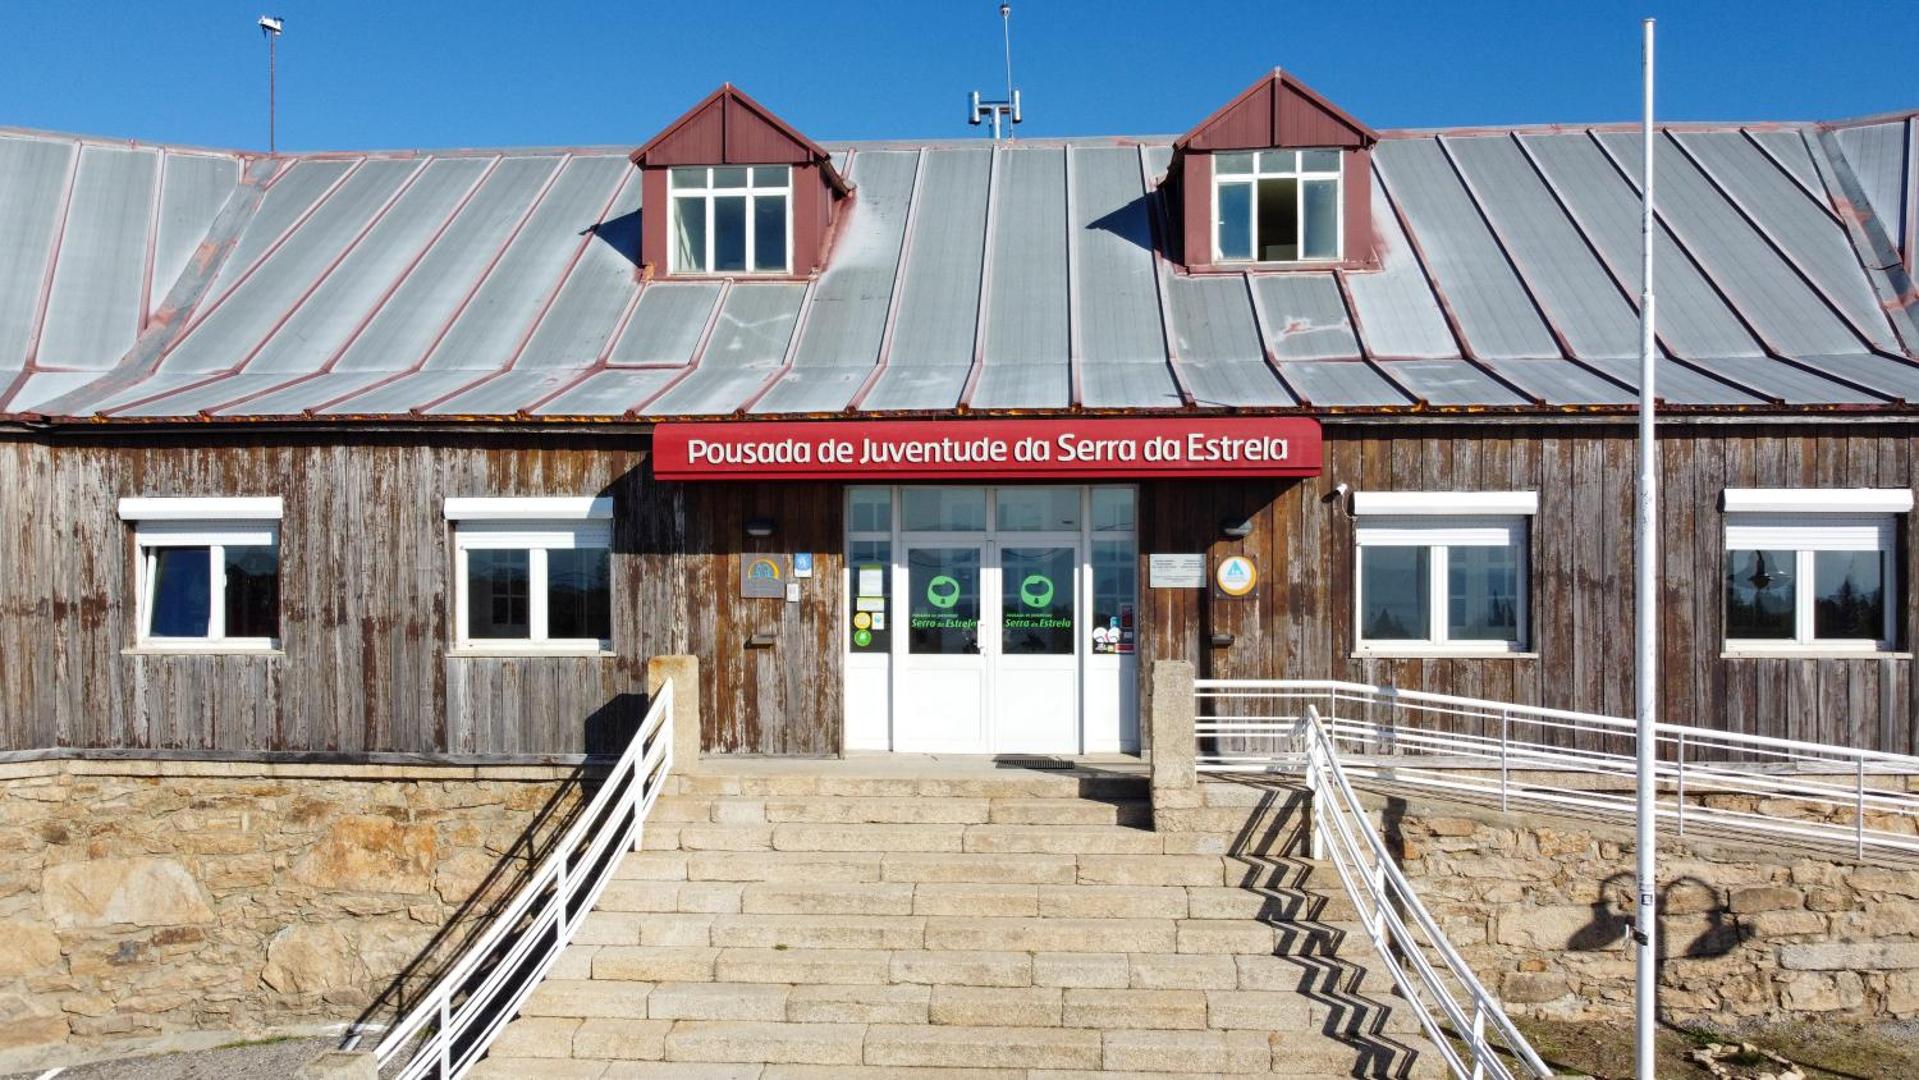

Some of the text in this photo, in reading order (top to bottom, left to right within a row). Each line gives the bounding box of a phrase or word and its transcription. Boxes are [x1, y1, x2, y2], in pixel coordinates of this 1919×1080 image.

[687, 433, 1289, 464] Pousada de Juventude da Serra da Estrela
[911, 618, 936, 628] Serra
[945, 618, 977, 628] Estrela
[1004, 618, 1030, 628] Serra
[1039, 618, 1071, 628] Estrela
